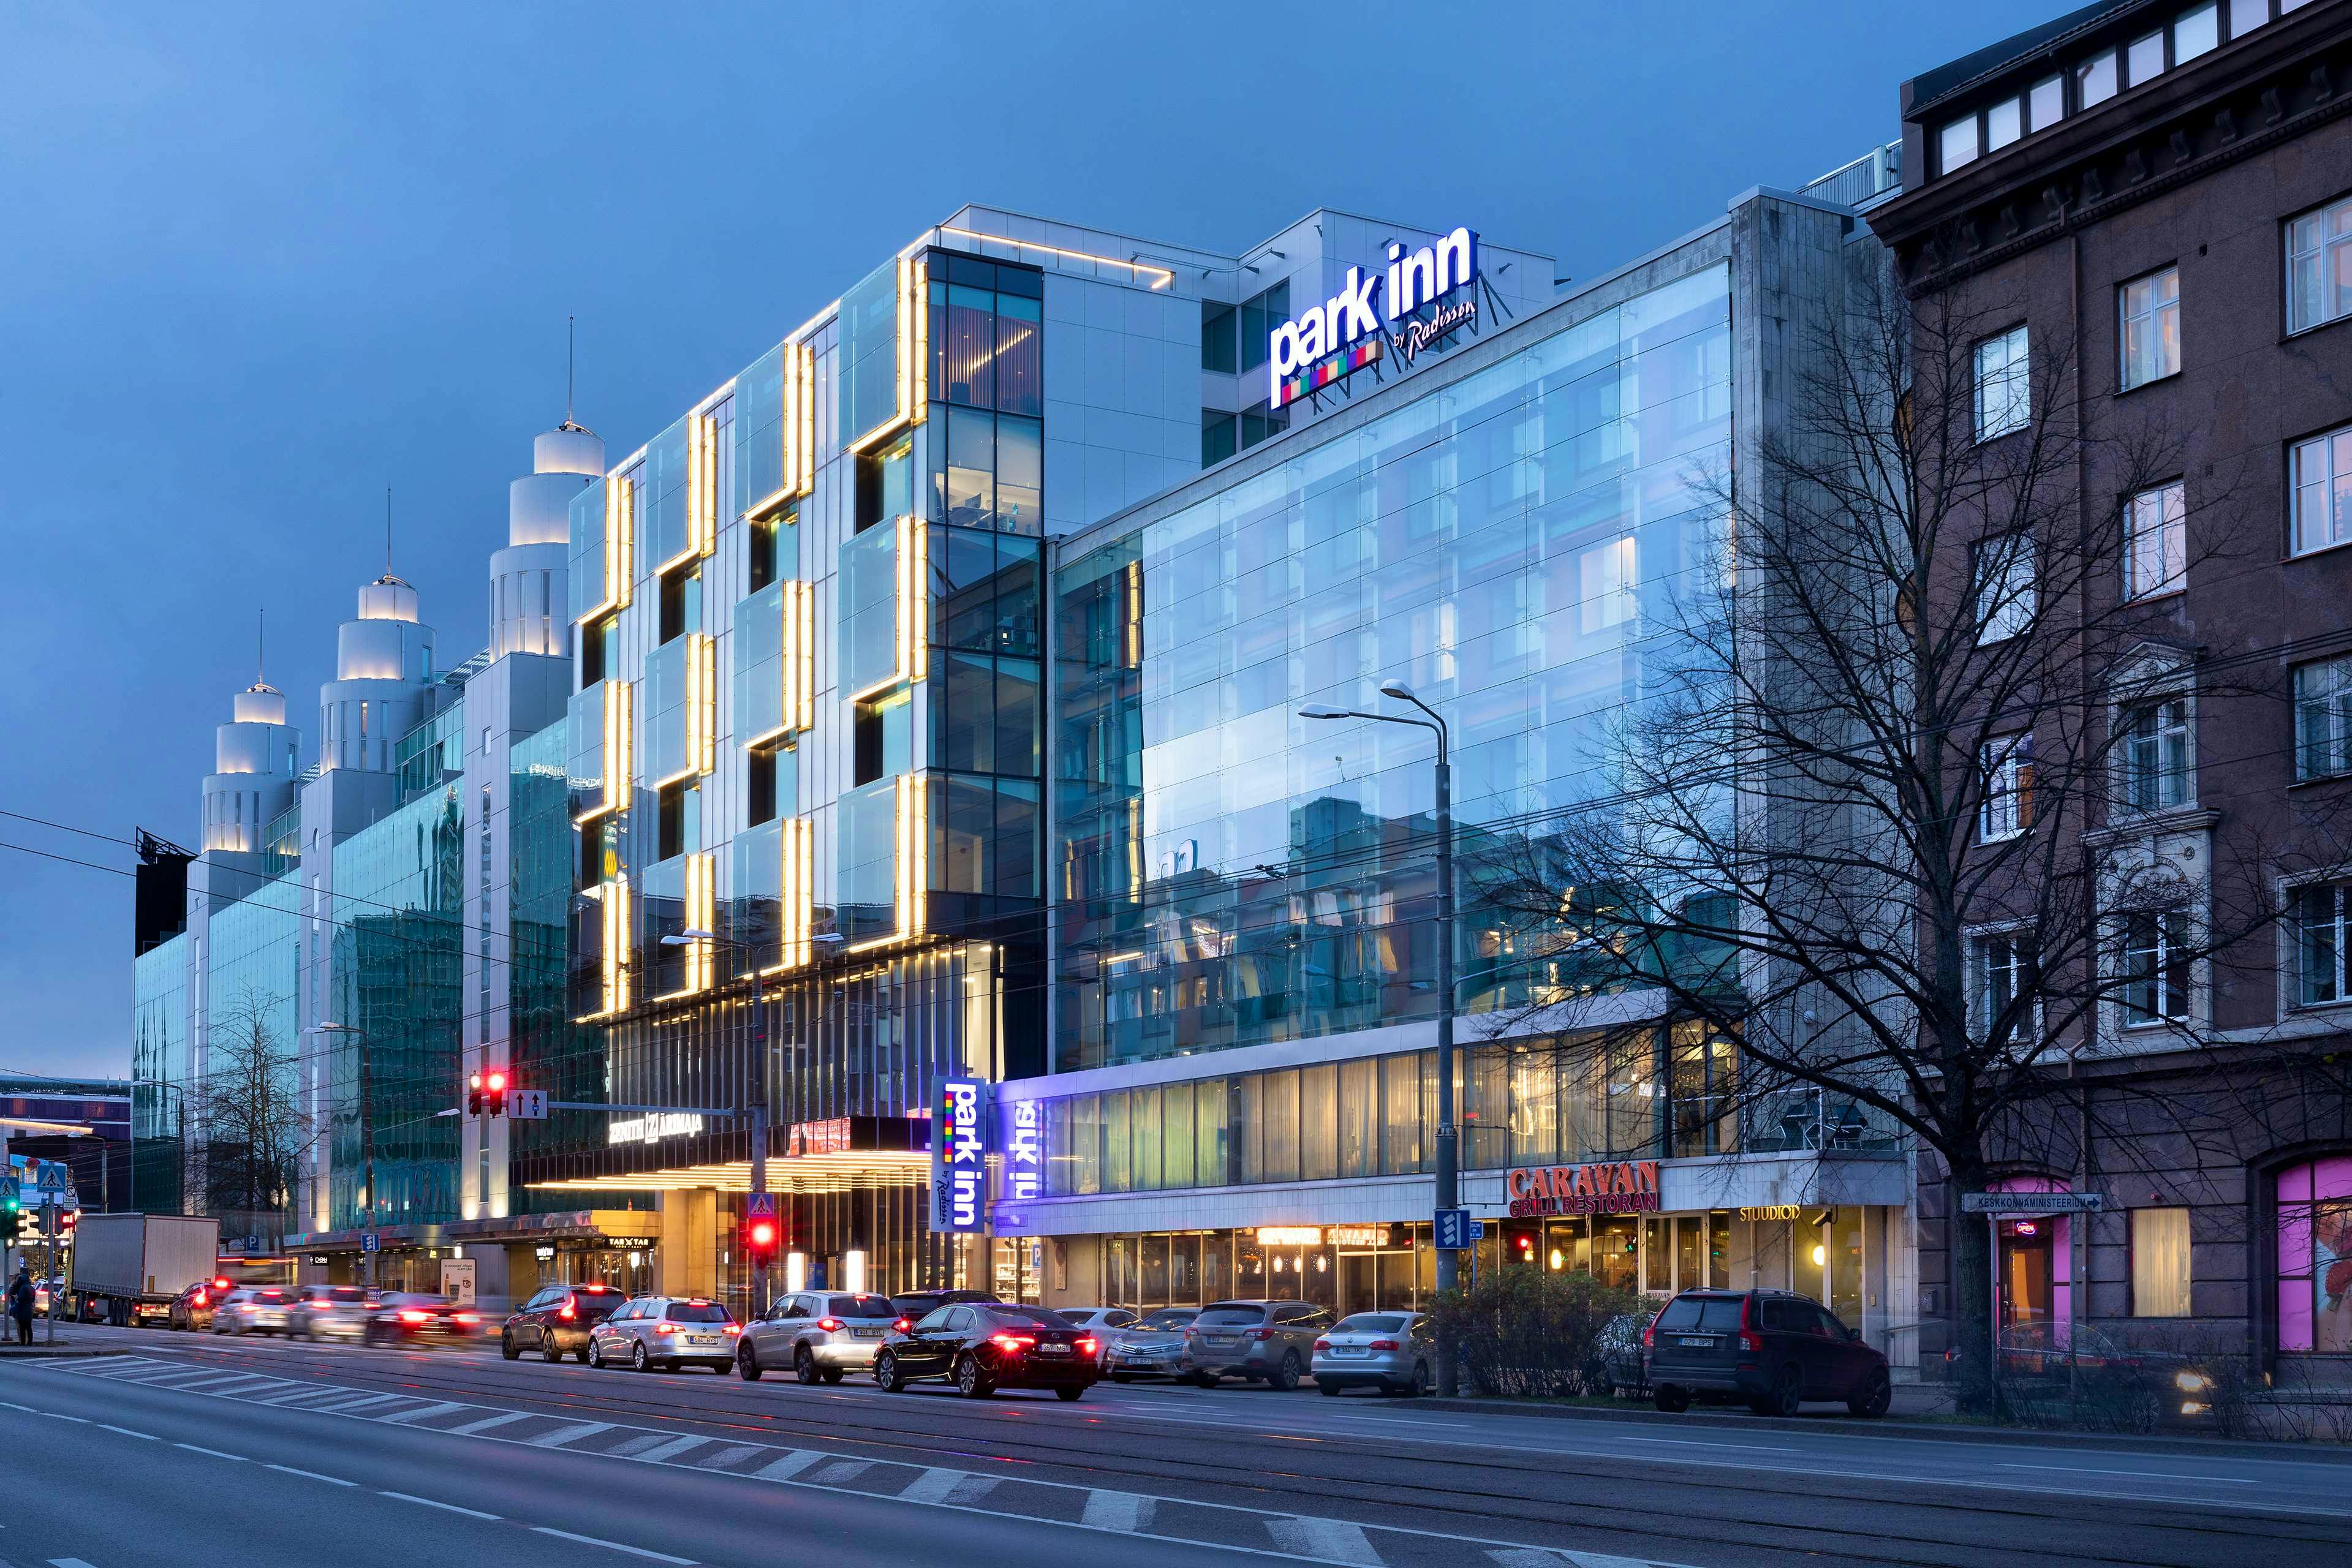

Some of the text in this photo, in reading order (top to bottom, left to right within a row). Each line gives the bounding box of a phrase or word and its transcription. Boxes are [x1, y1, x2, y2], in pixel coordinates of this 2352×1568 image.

[1270, 227, 1476, 412] park inn
[1394, 299, 1476, 360] by Radisson
[609, 1118, 645, 1144] ZENITH
[659, 1113, 703, 1138] ÄRIMAJA
[945, 1083, 982, 1226] park inn
[1509, 1161, 1660, 1199] CARAVAN
[936, 1170, 950, 1224] by Radisson
[1509, 1192, 1660, 1219] GRILL RESTORAN
[1978, 1197, 2087, 1208] KESKKONNAMINISTEERIUM
[1739, 1205, 1801, 1222] STUUDIOD
[249, 1236, 257, 1247] P
[1034, 1247, 1040, 1263] P
